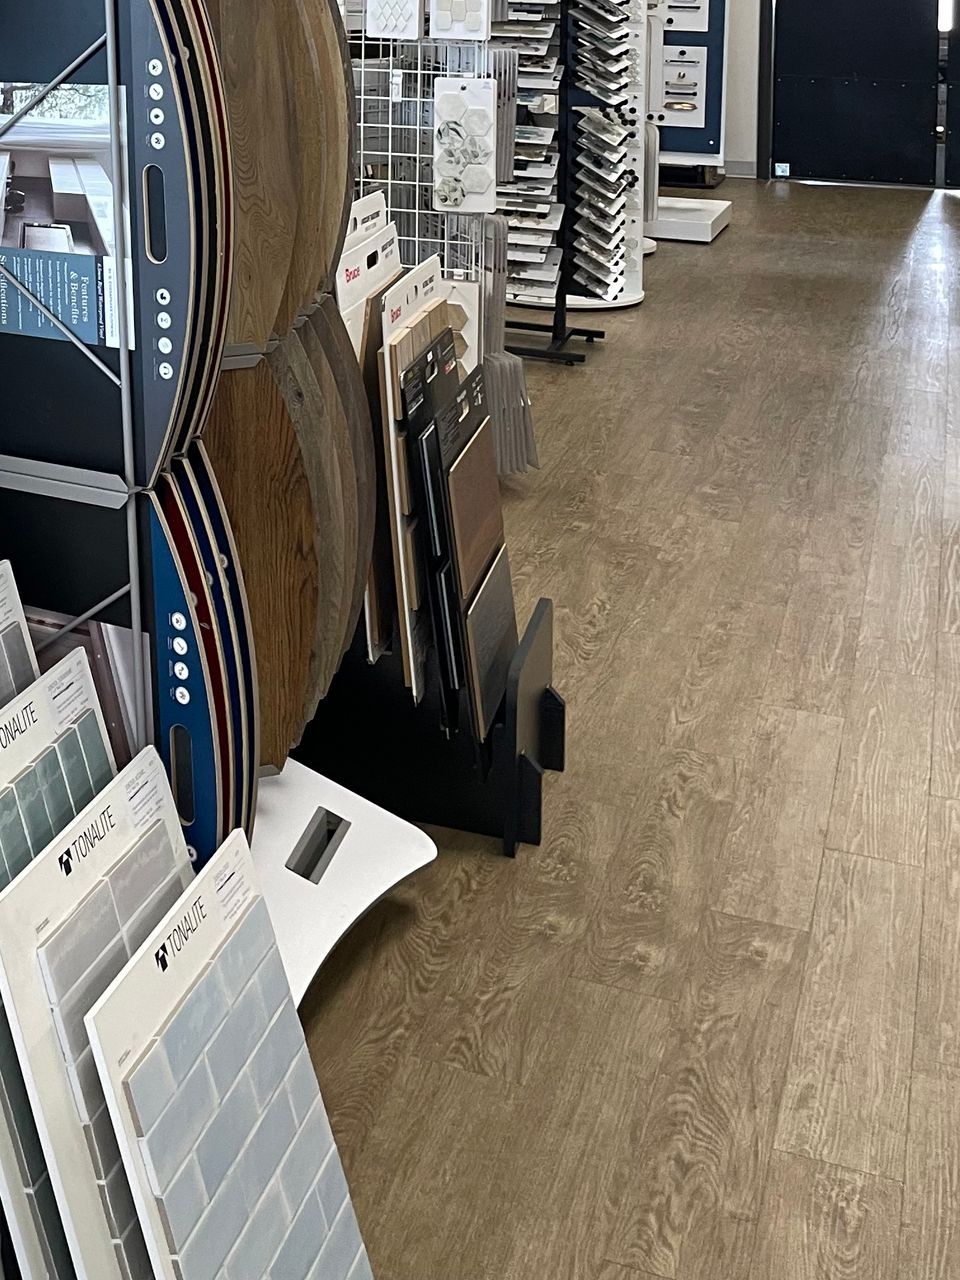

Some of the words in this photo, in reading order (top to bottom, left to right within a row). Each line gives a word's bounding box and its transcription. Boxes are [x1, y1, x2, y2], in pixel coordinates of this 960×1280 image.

[70, 282, 79, 324] Benefits
[81, 276, 89, 322] Features
[71, 805, 116, 862] TONALITE
[165, 896, 208, 958] TONALITE
